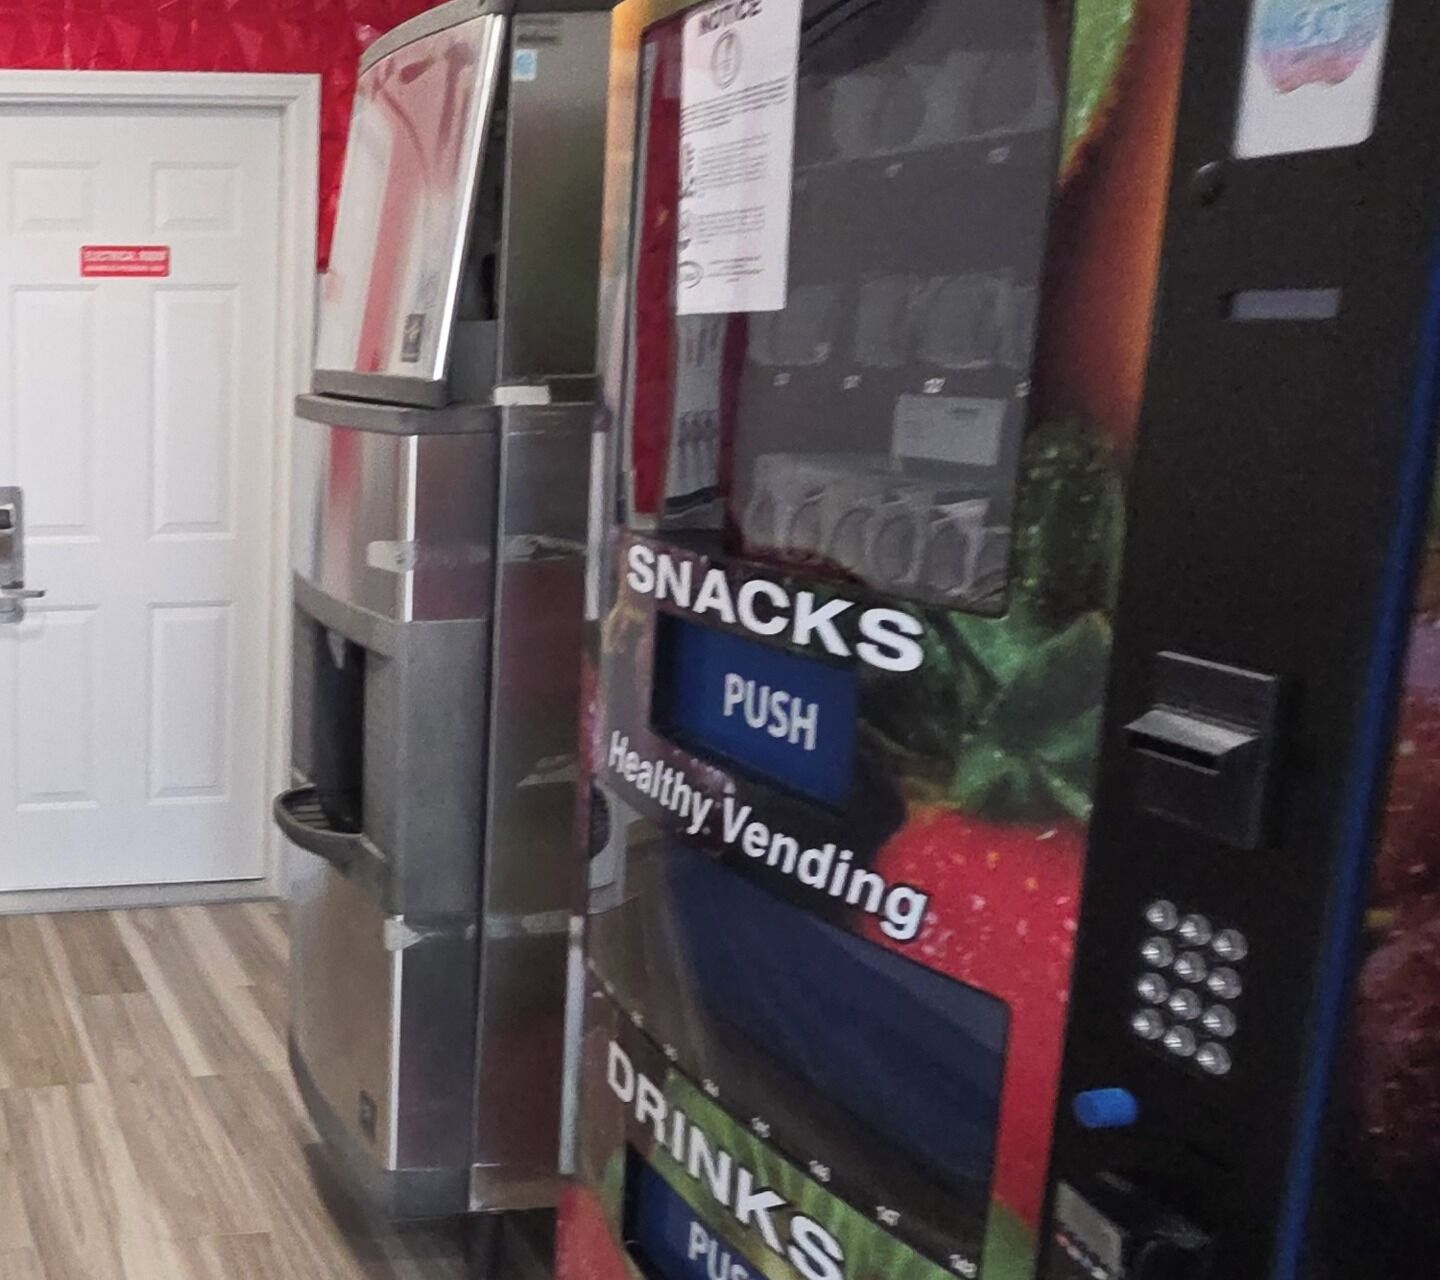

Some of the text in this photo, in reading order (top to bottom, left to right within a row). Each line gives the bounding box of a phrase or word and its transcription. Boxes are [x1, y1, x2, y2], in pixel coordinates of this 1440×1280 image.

[626, 544, 924, 672] SNACKS
[723, 672, 819, 751] PUSH
[608, 730, 930, 941] Healthy Vending
